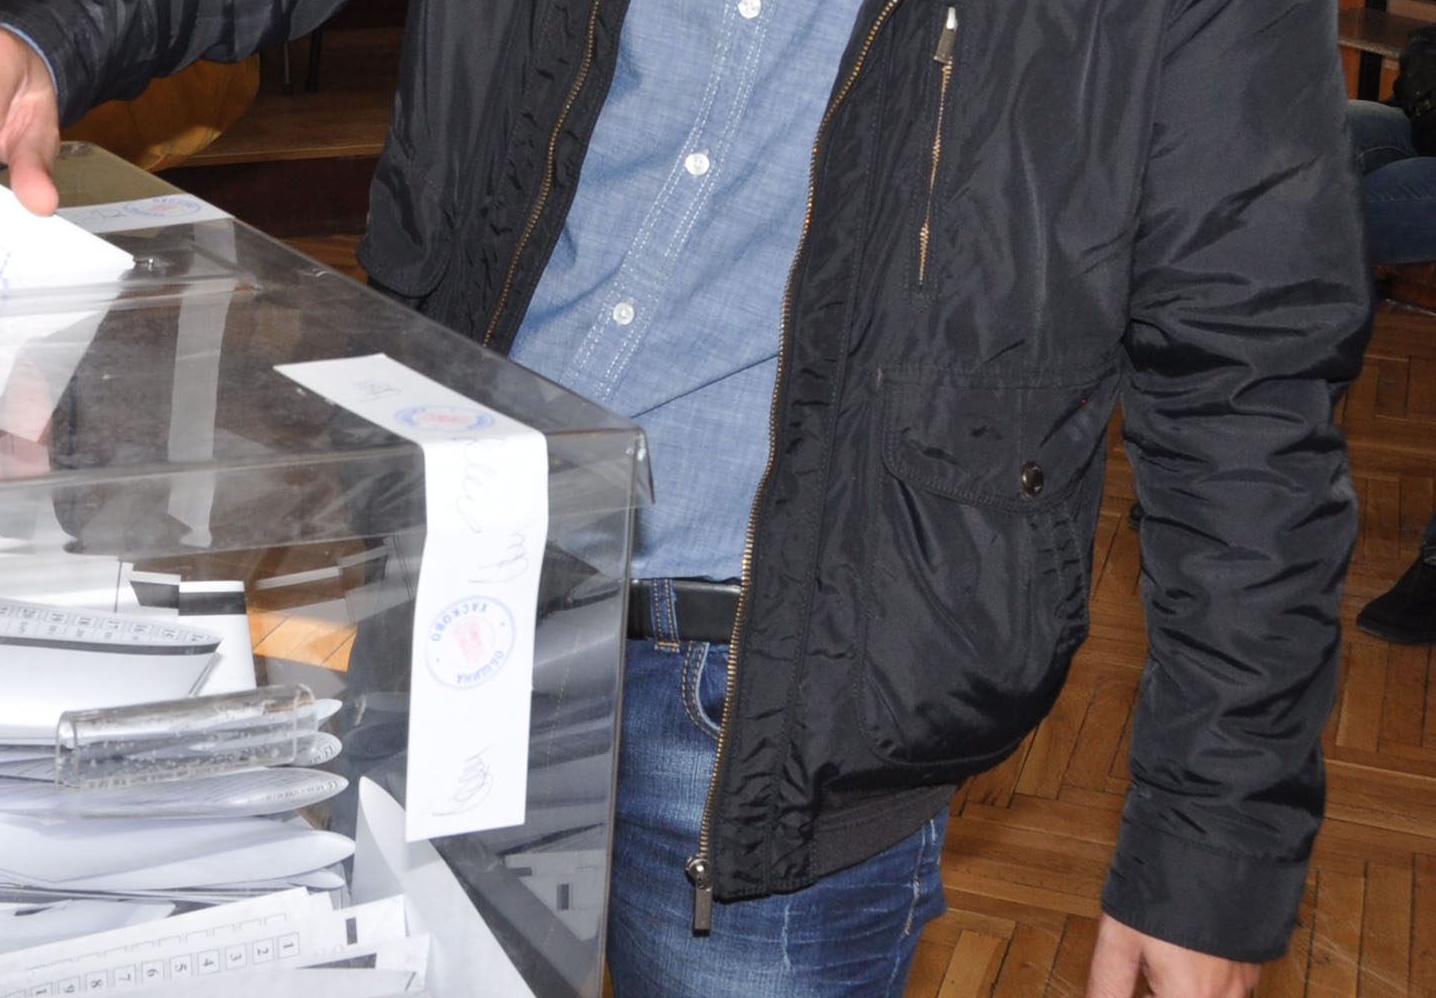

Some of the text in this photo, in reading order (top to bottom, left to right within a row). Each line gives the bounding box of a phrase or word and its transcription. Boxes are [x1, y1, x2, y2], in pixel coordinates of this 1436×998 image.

[52, 613, 65, 623] 19
[431, 602, 489, 642] ХАСКОВО
[108, 620, 120, 630] 17
[456, 650, 504, 684] ОБЩИНА
[284, 941, 294, 950] 1
[257, 947, 269, 956] 2
[229, 953, 242, 961] 3
[202, 958, 215, 967] 4
[147, 968, 160, 978] 6
[175, 964, 188, 973] 5
[118, 973, 131, 982] 7
[91, 979, 103, 988] 8
[63, 984, 75, 994] 9
